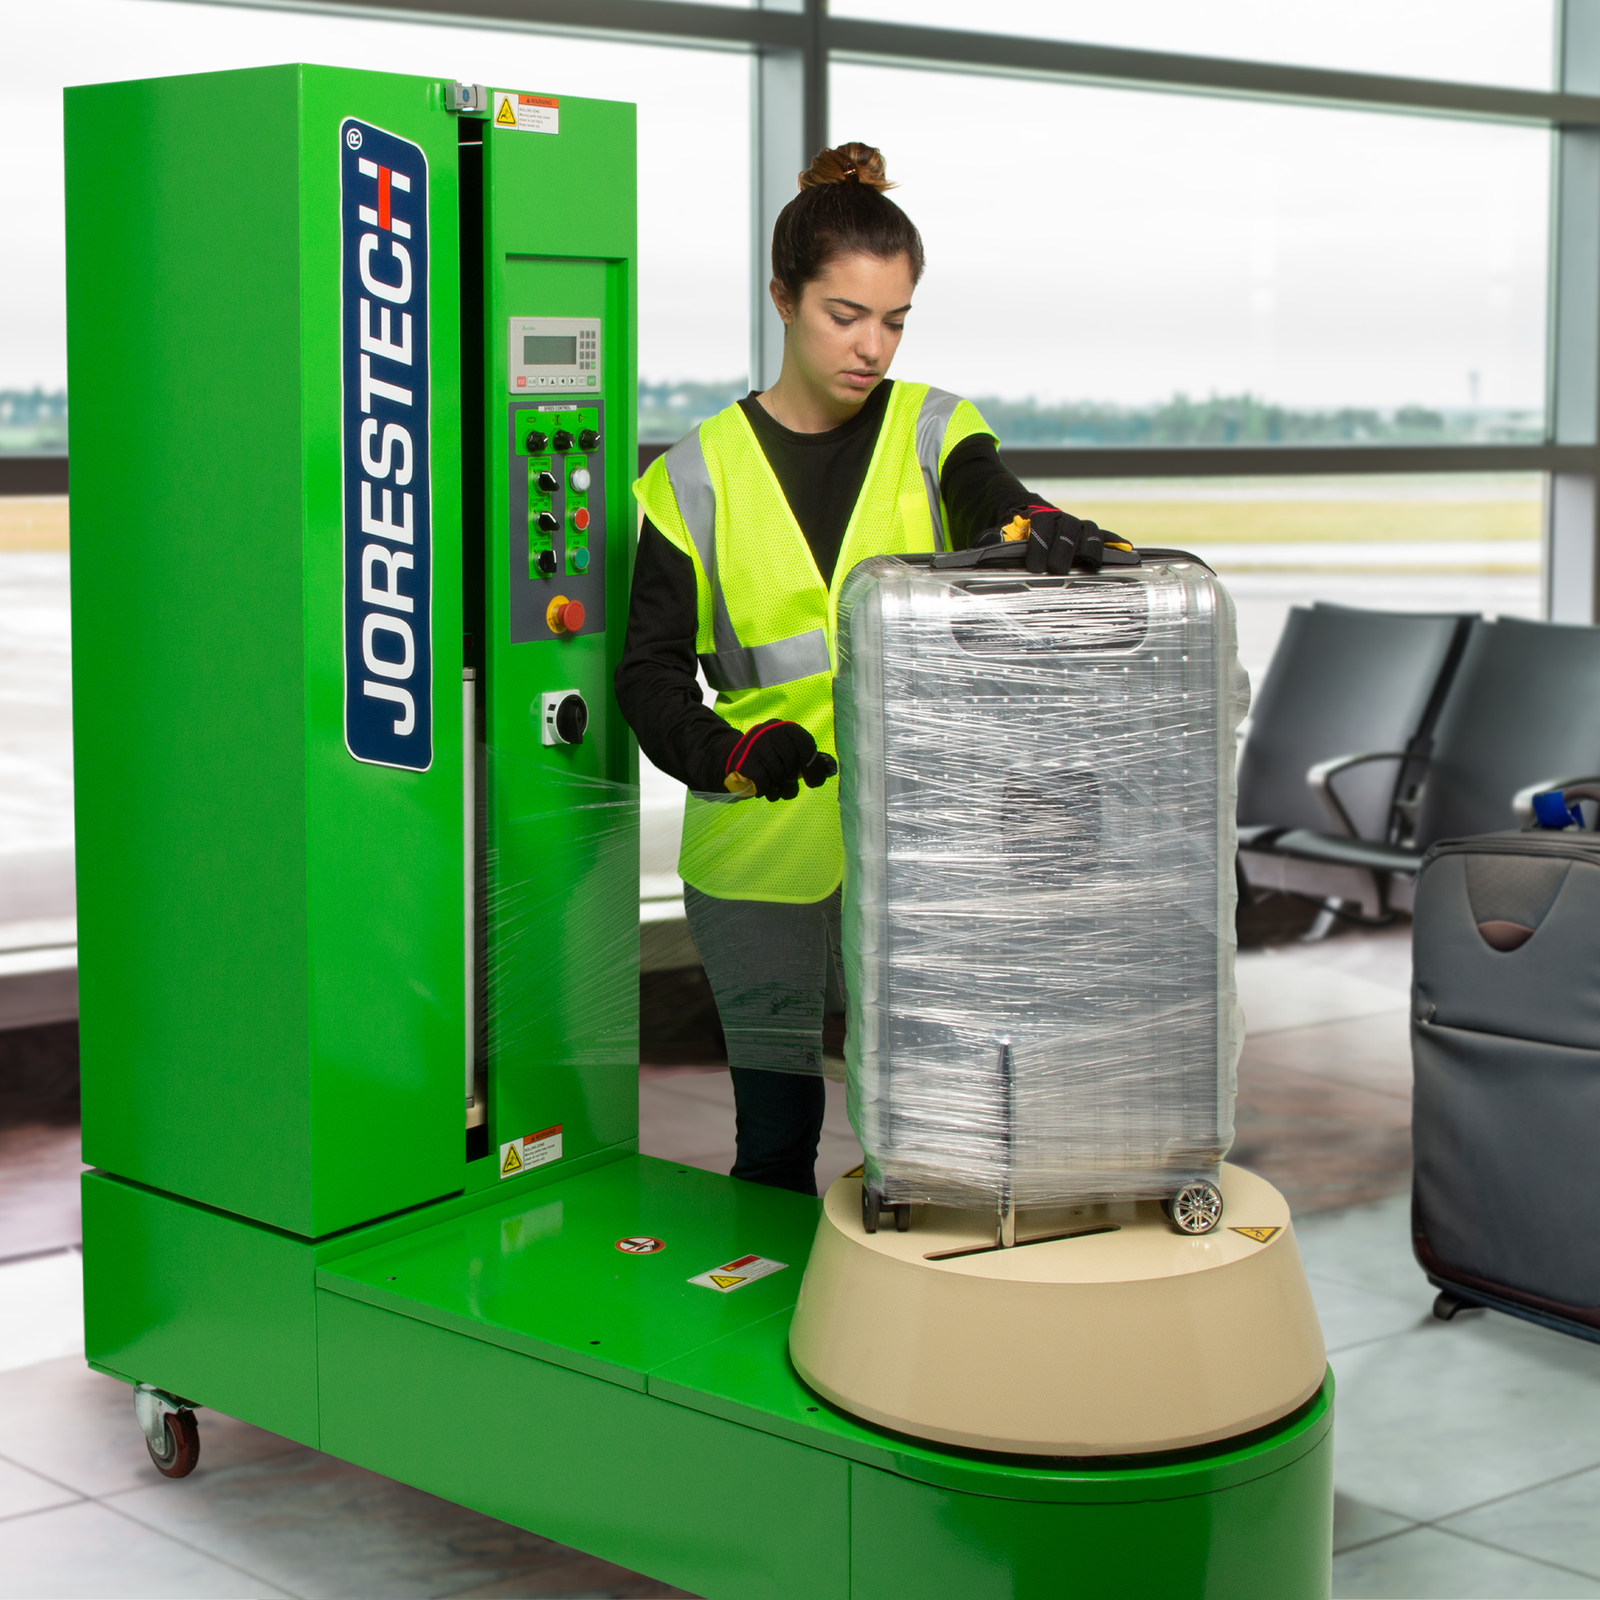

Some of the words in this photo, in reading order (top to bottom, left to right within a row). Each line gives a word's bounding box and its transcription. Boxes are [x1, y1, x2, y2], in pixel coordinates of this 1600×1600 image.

[530, 98, 552, 106] WARNING
[359, 157, 415, 736] JORESTECH
[535, 1128, 556, 1139] WARNING
